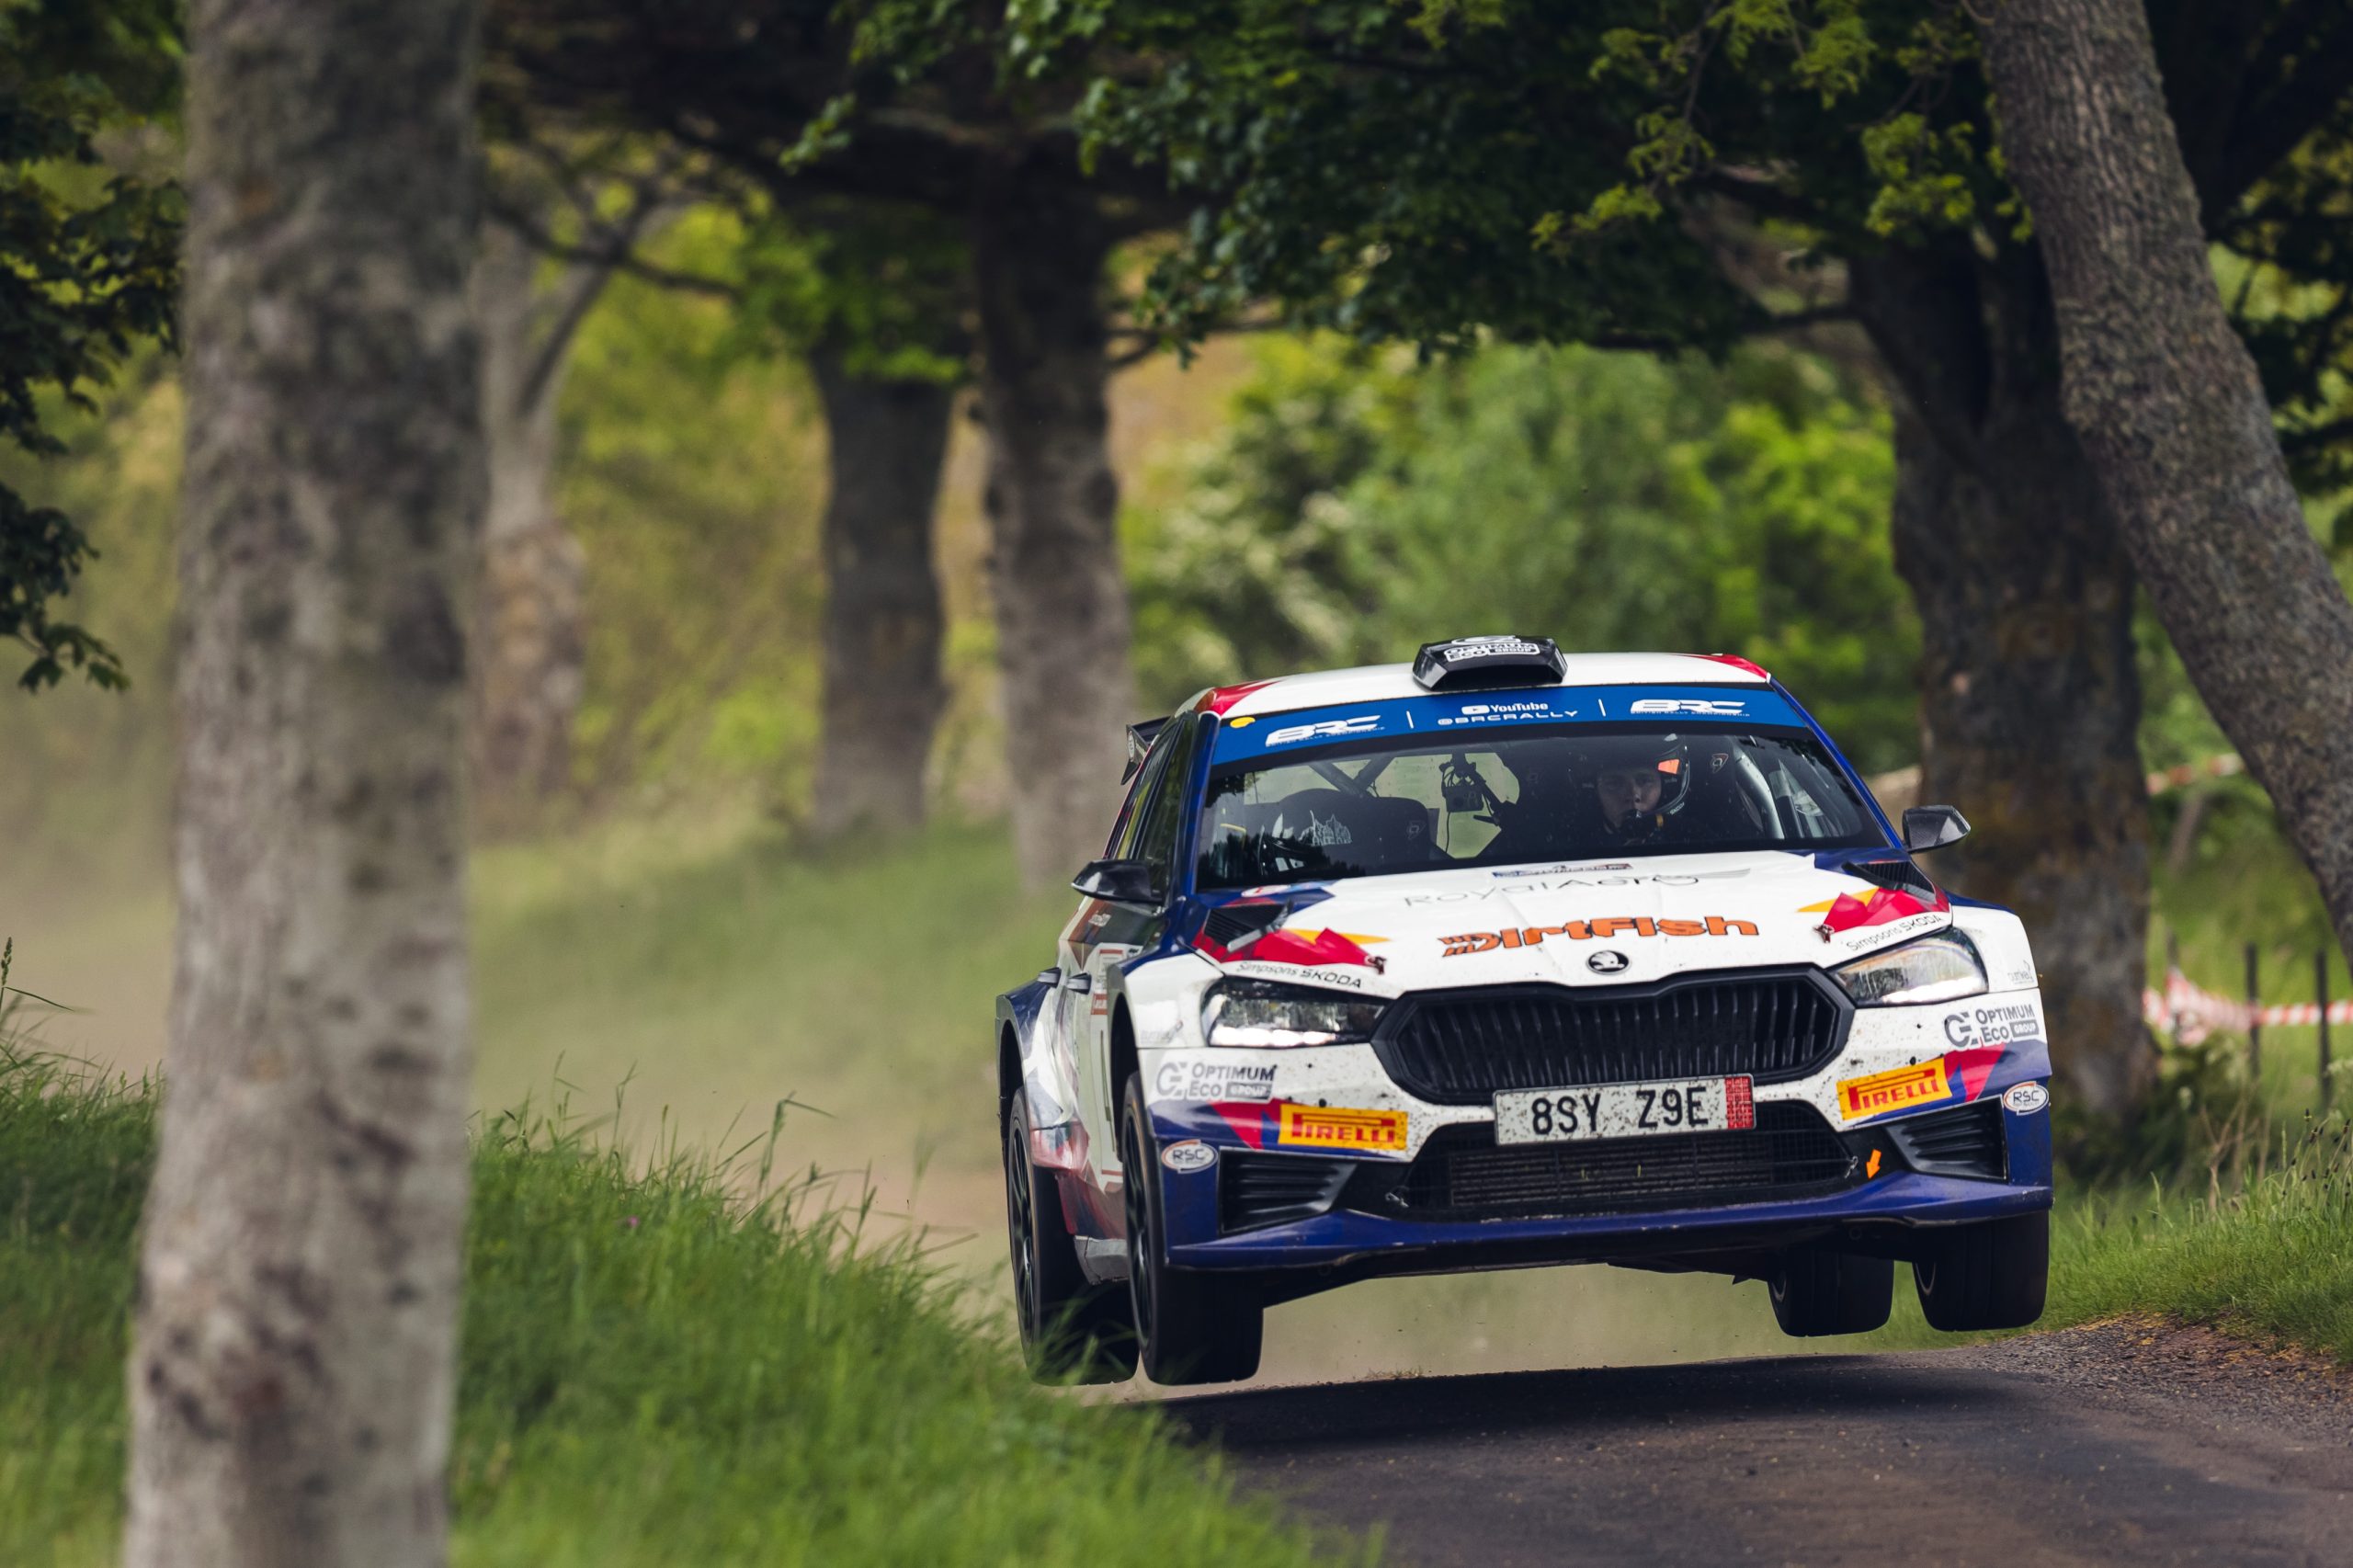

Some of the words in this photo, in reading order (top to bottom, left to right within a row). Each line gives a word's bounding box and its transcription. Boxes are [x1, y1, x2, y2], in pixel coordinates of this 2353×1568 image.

[1490, 702, 1549, 713] YouTube
[1846, 926, 1903, 951] Simpsons
[1236, 960, 1298, 976] Simpsons
[2014, 1024, 2037, 1033] GROUP
[1847, 1068, 1941, 1111] PIRELLI
[2013, 1090, 2040, 1104] RSC
[1531, 1093, 1601, 1135] 8SY
[1635, 1086, 1710, 1130] Z9E
[1291, 1113, 1396, 1142] PIRELLI
[1173, 1148, 1205, 1161] RSC
